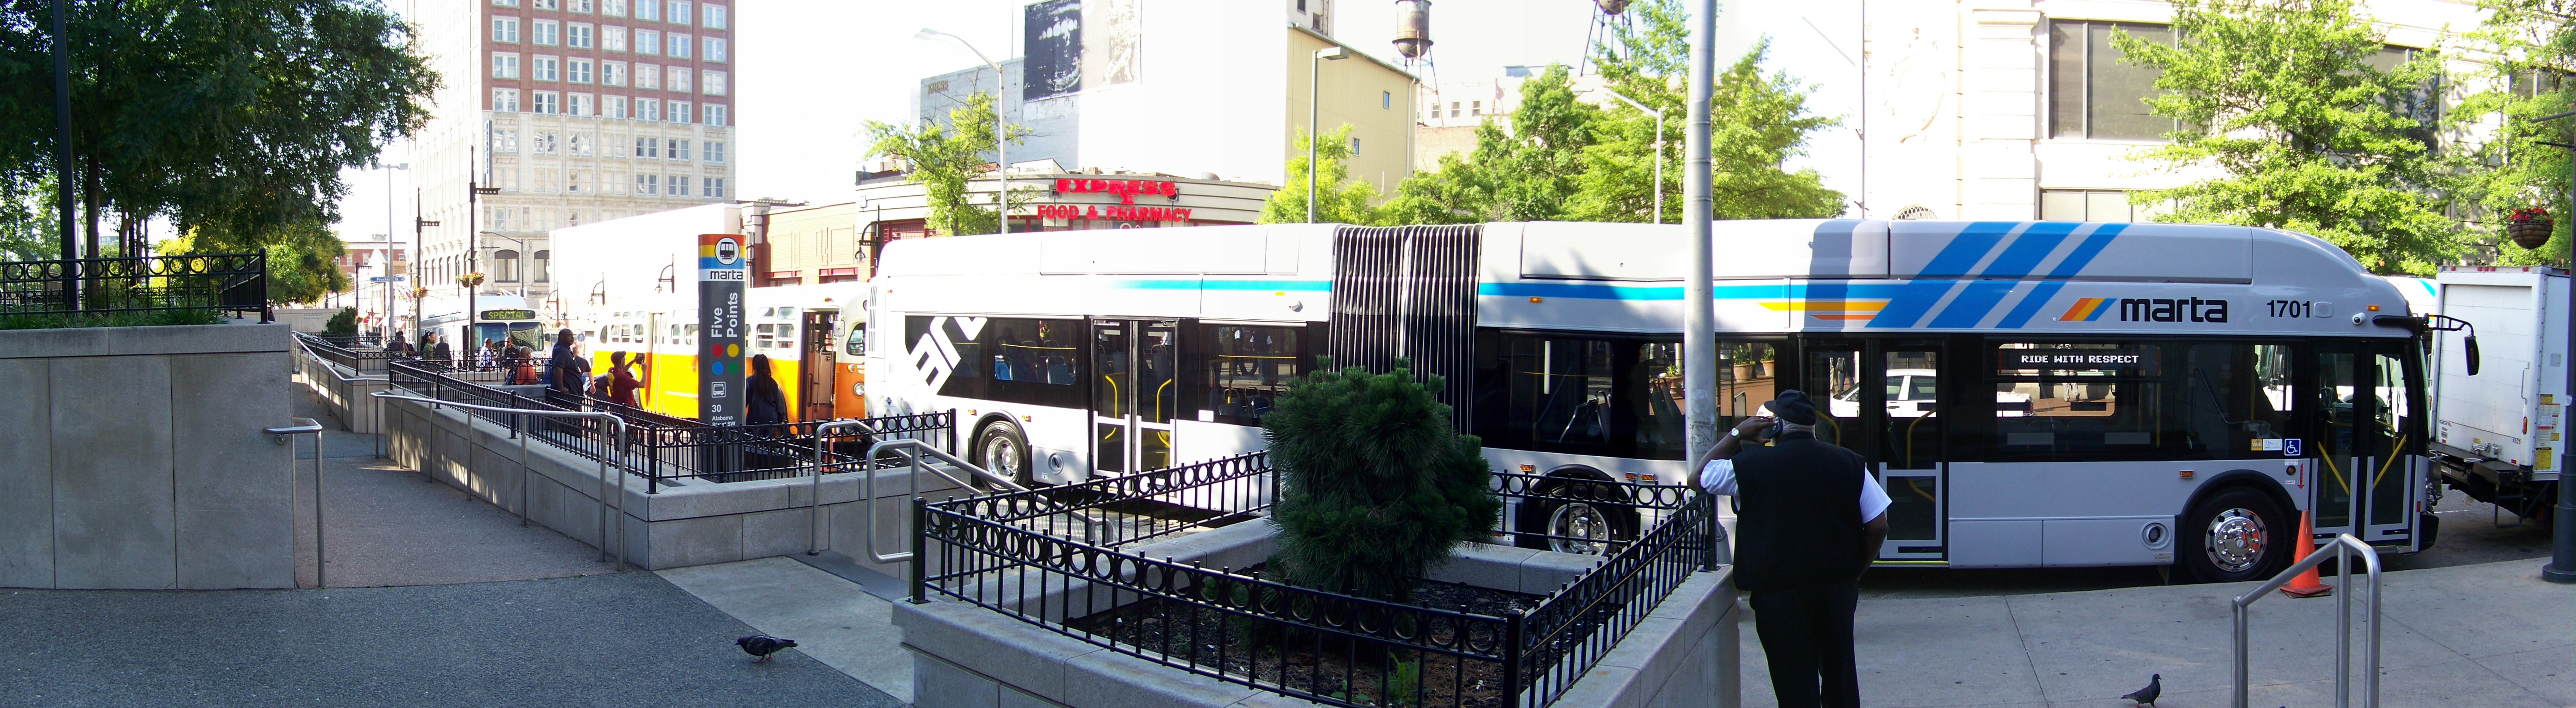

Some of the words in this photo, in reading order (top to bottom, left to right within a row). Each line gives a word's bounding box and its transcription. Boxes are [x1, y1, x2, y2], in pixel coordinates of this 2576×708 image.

[928, 80, 949, 93] KRESS
[1056, 179, 1176, 196] EXPRESS
[1037, 205, 1079, 219] FOOD
[1086, 205, 1098, 220] &
[1106, 205, 1192, 222] PHARMACY
[710, 270, 743, 280] marta
[488, 311, 527, 320] SPECIAL
[727, 292, 738, 338] Points
[2120, 296, 2228, 323] marta
[2267, 300, 2311, 318] 1701
[711, 307, 723, 338] Five
[2021, 355, 2049, 363] RIDE
[2054, 355, 2083, 363] WITH
[2088, 355, 2139, 363] RESPECT
[712, 404, 722, 413] 30
